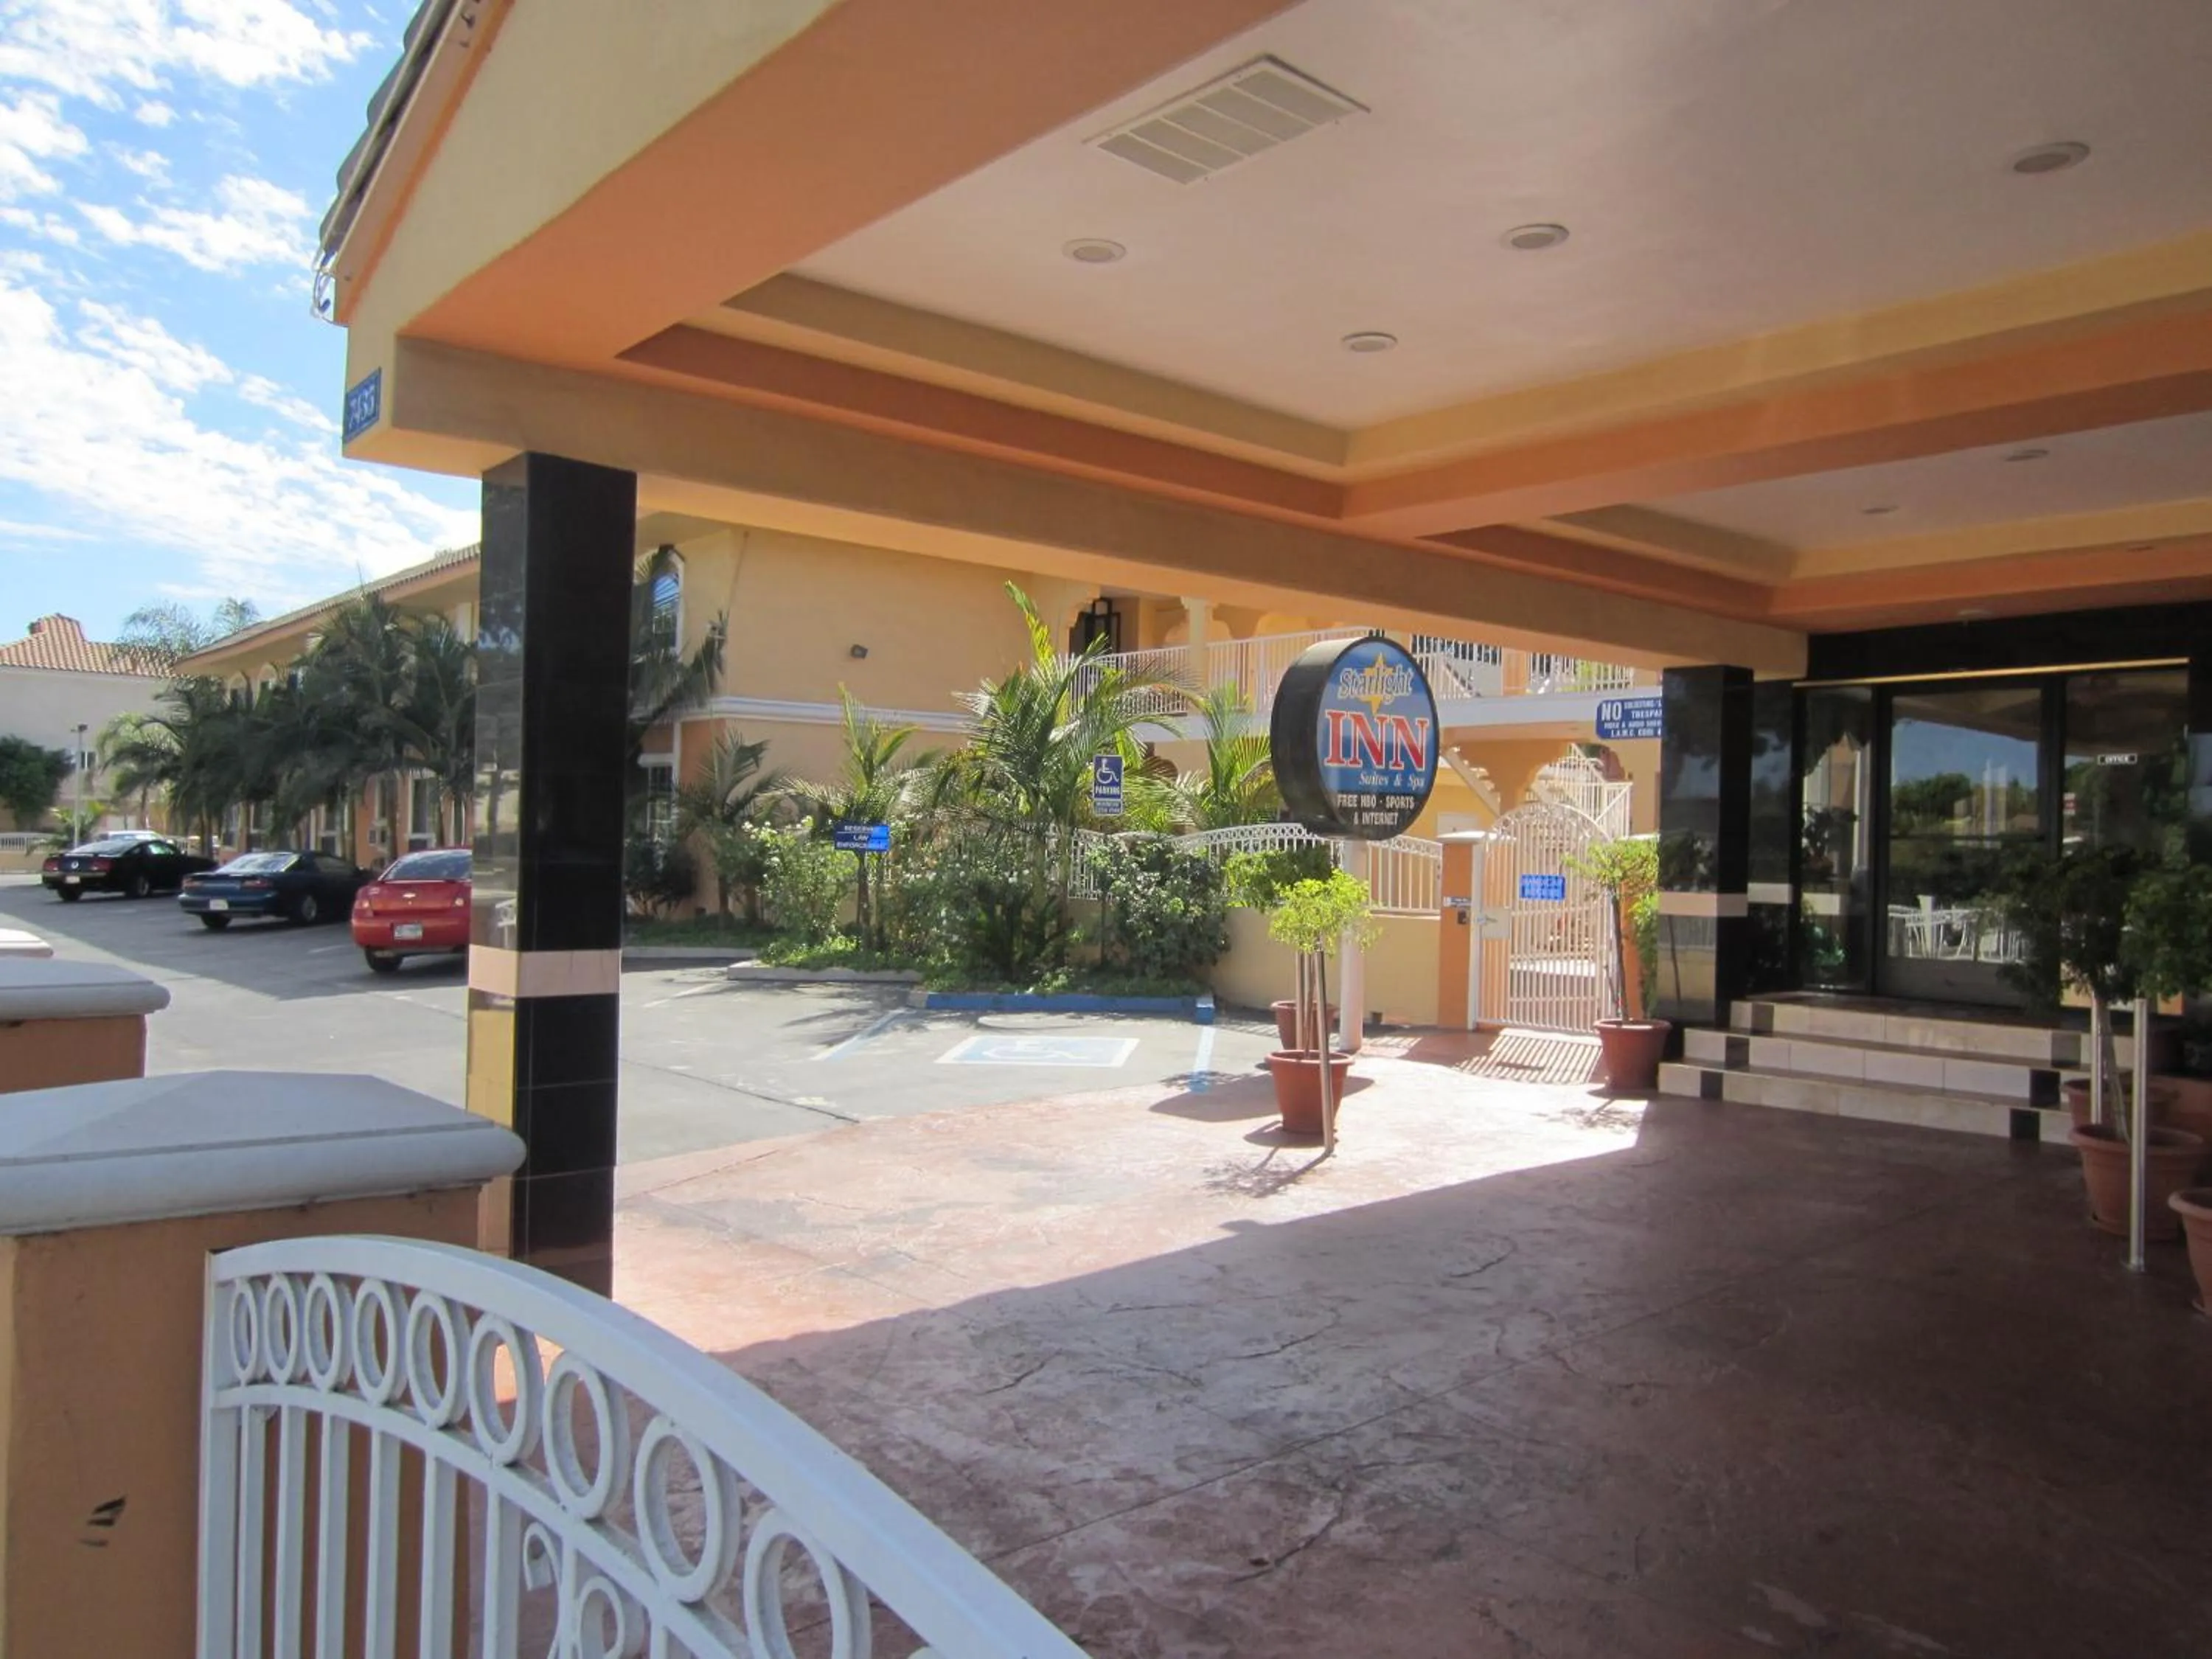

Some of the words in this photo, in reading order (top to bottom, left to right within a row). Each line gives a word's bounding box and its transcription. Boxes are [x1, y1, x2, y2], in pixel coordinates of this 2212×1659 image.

[1338, 666, 1414, 706] Starlight
[1601, 702, 1621, 720] NO
[1324, 709, 1429, 771] INN
[1359, 772, 1389, 787] Suites
[1394, 773, 1401, 786] &
[1408, 773, 1425, 791] Spa
[1337, 794, 1357, 807] FREE
[1361, 795, 1377, 808] HBO
[1385, 796, 1415, 810] SPORTS
[1353, 812, 1359, 826] &
[1362, 812, 1399, 826] INTERNET
